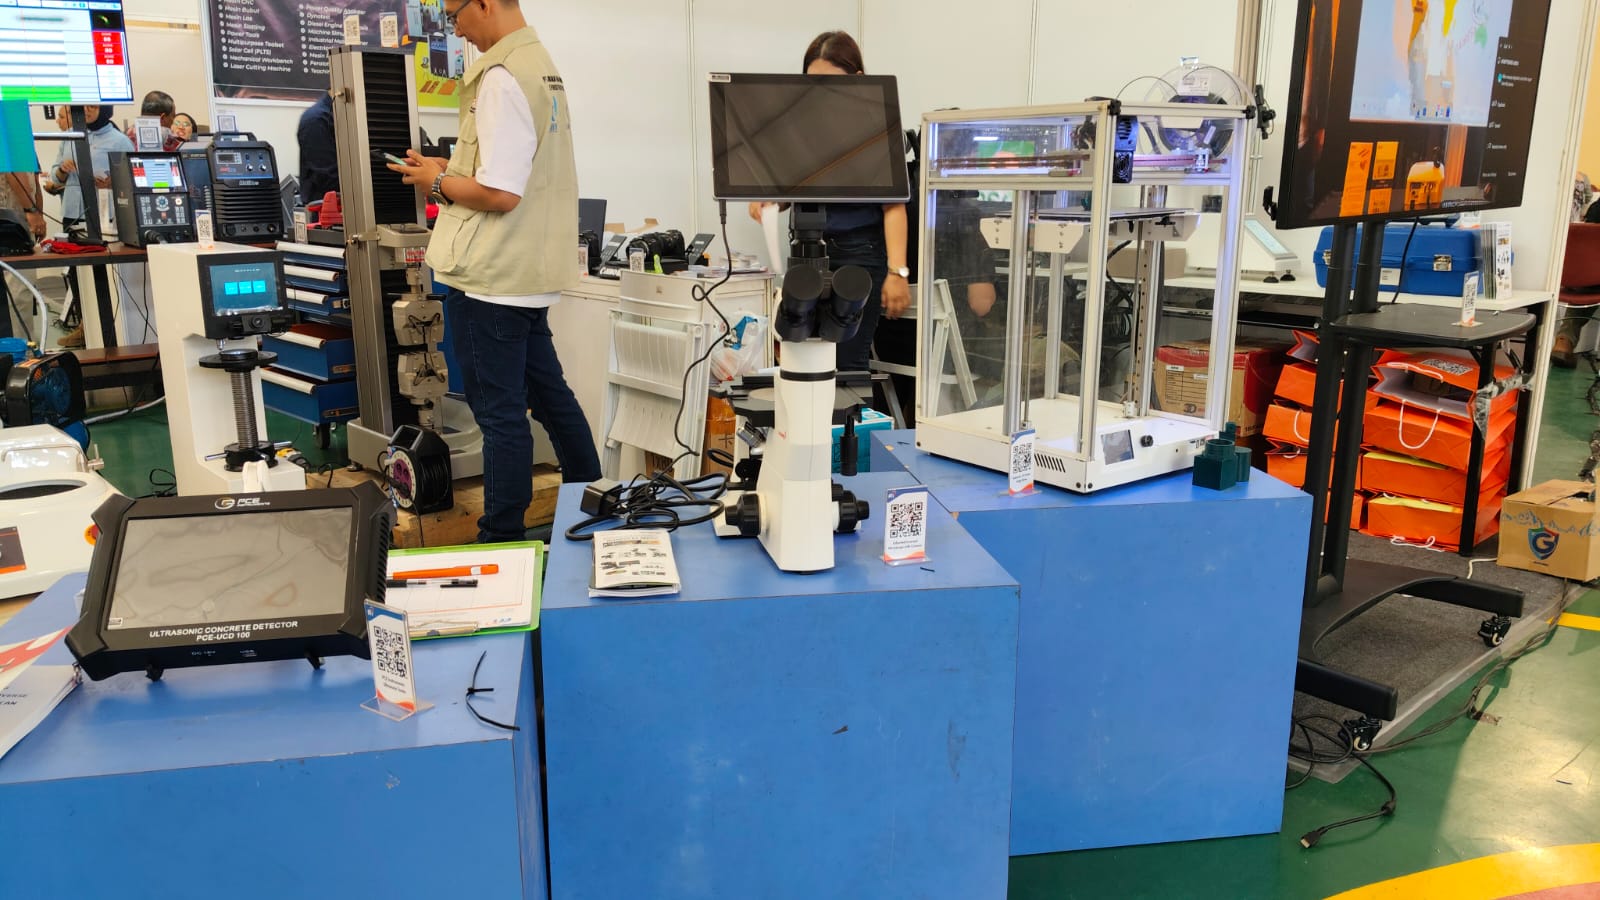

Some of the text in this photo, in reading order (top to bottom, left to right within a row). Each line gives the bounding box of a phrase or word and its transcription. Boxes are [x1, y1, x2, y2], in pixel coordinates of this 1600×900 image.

[150, 620, 298, 638] ULTRASONIC CONCRETE DETECTOR
[196, 632, 234, 642] PCE-UCD
